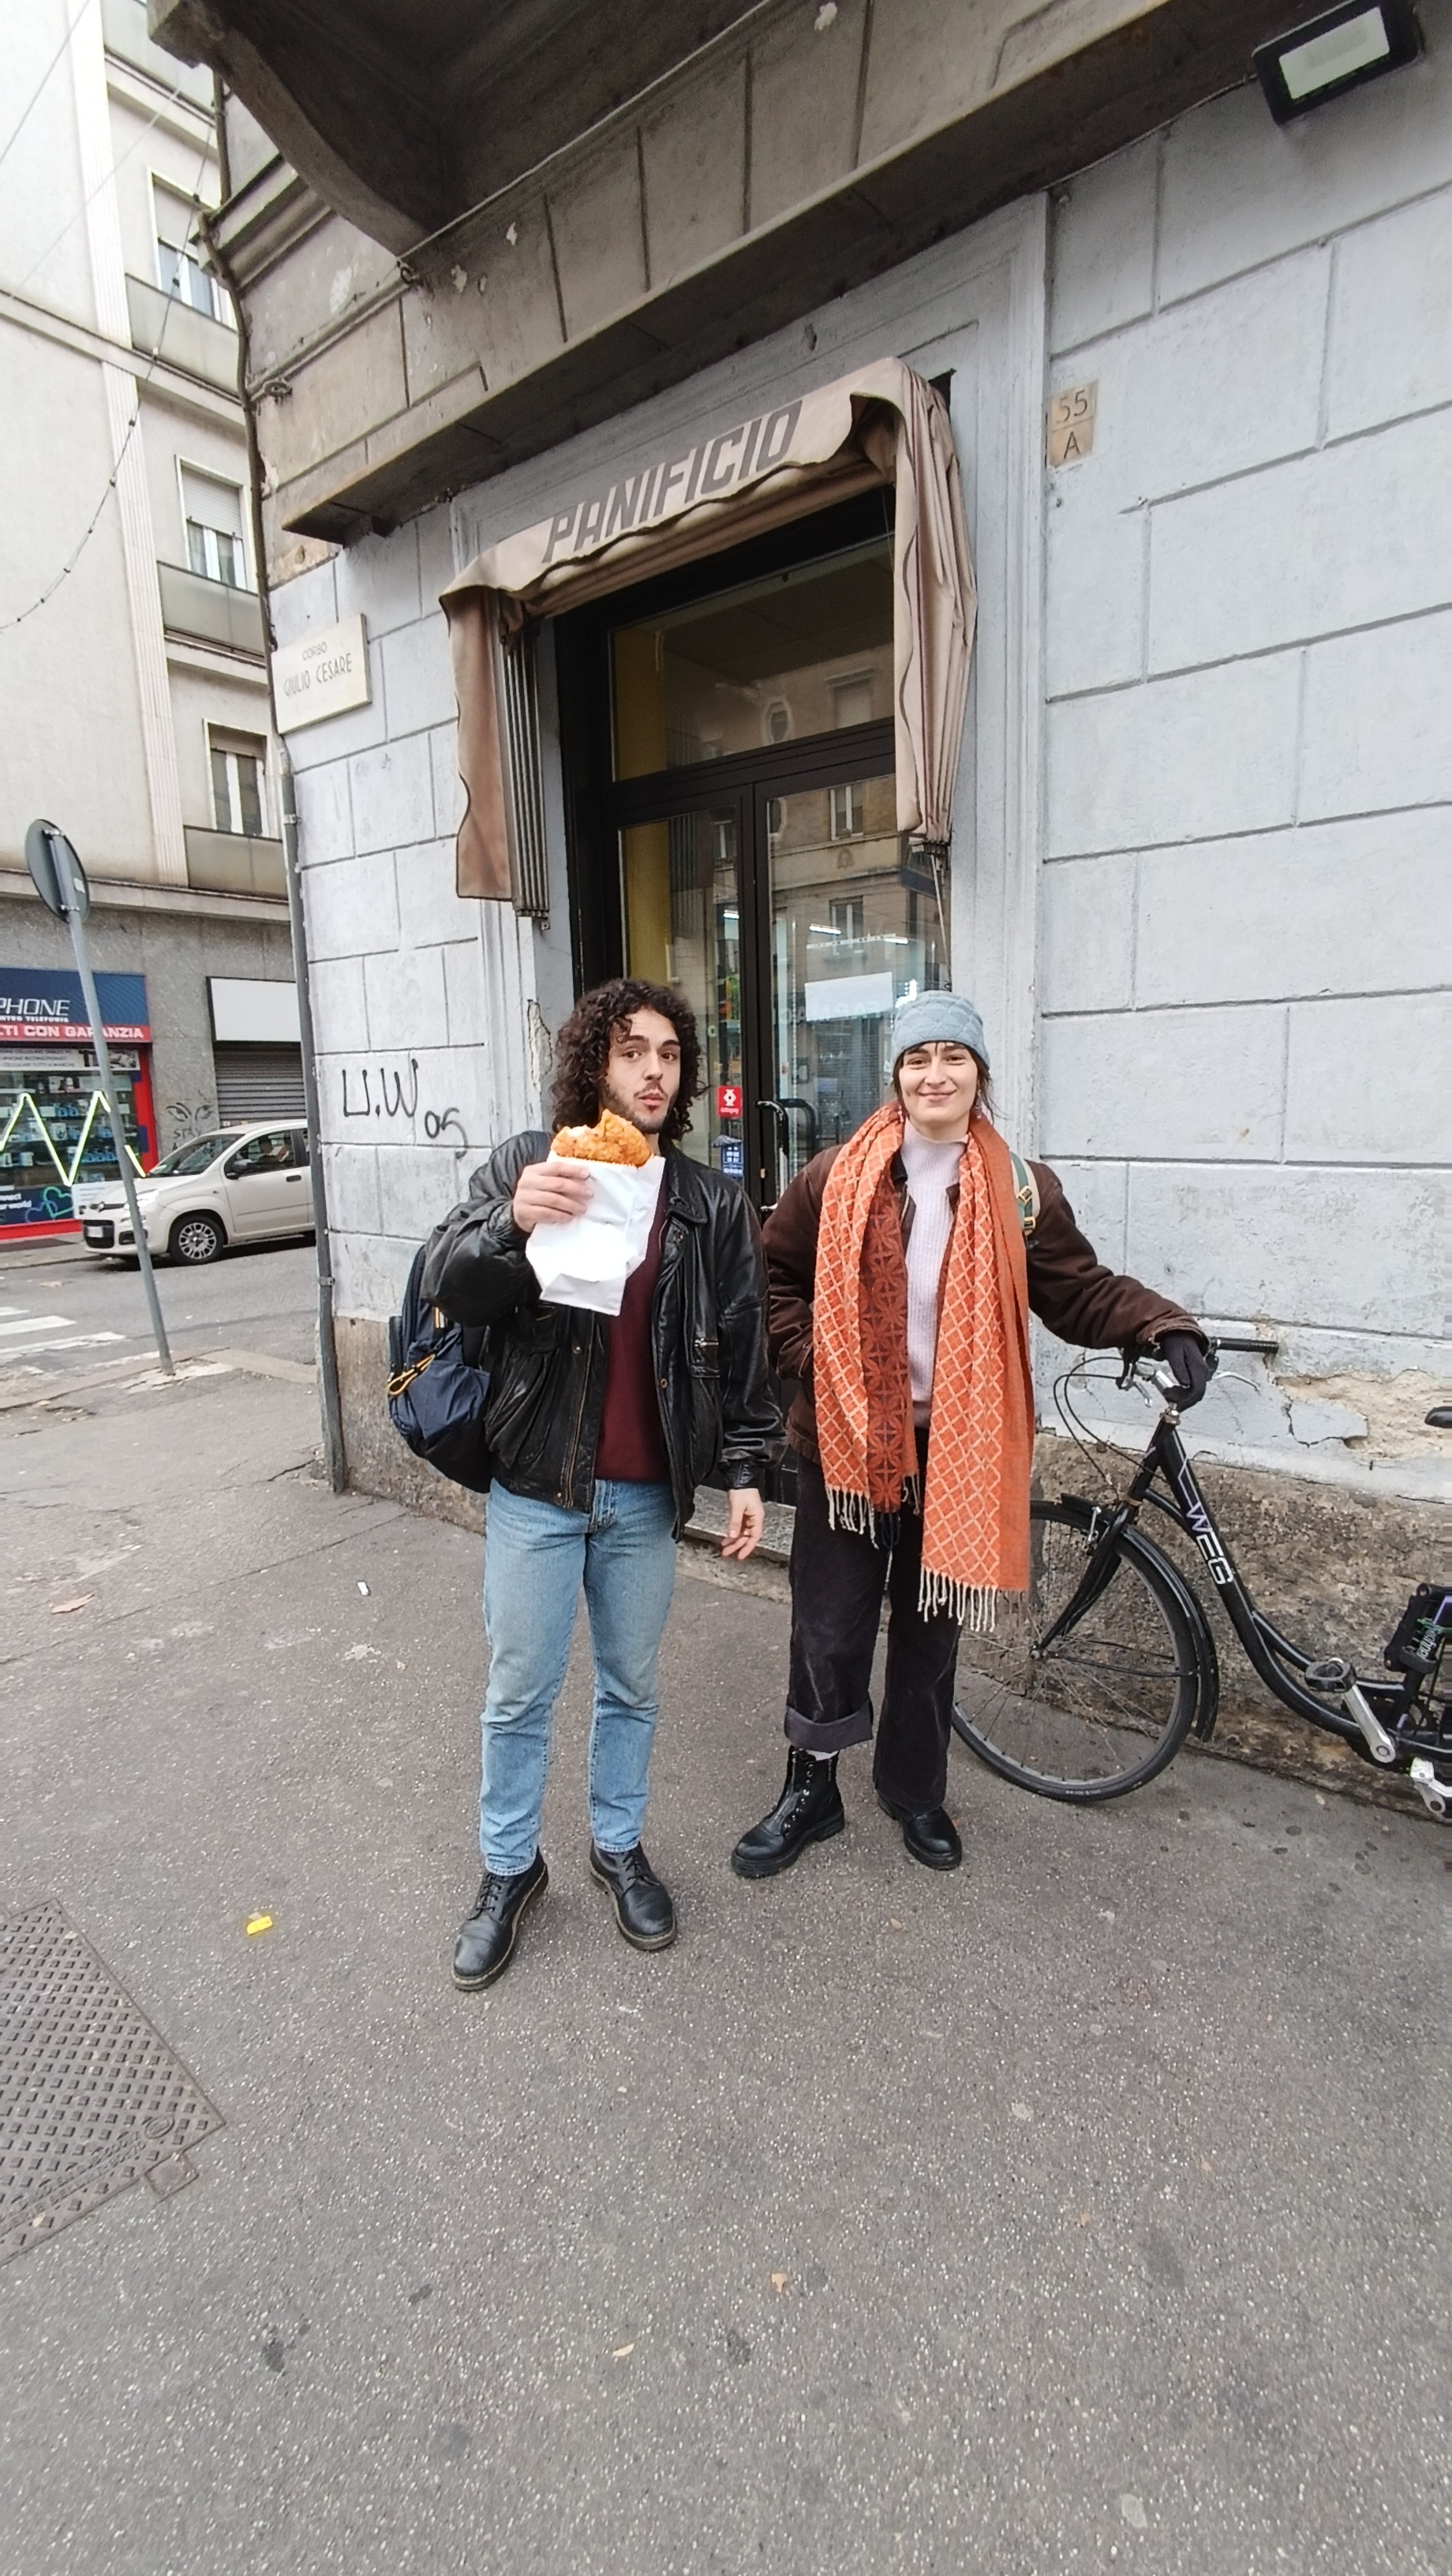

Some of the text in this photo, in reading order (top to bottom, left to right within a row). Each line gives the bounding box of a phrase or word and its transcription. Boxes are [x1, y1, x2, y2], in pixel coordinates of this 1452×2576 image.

[1056, 389, 1088, 422] 55
[1063, 431, 1081, 459] A
[541, 399, 803, 564] PANIFICIO
[301, 641, 327, 661] CORSO
[283, 653, 353, 696] GIULIO CESARE
[24, 1025, 60, 1037] CON
